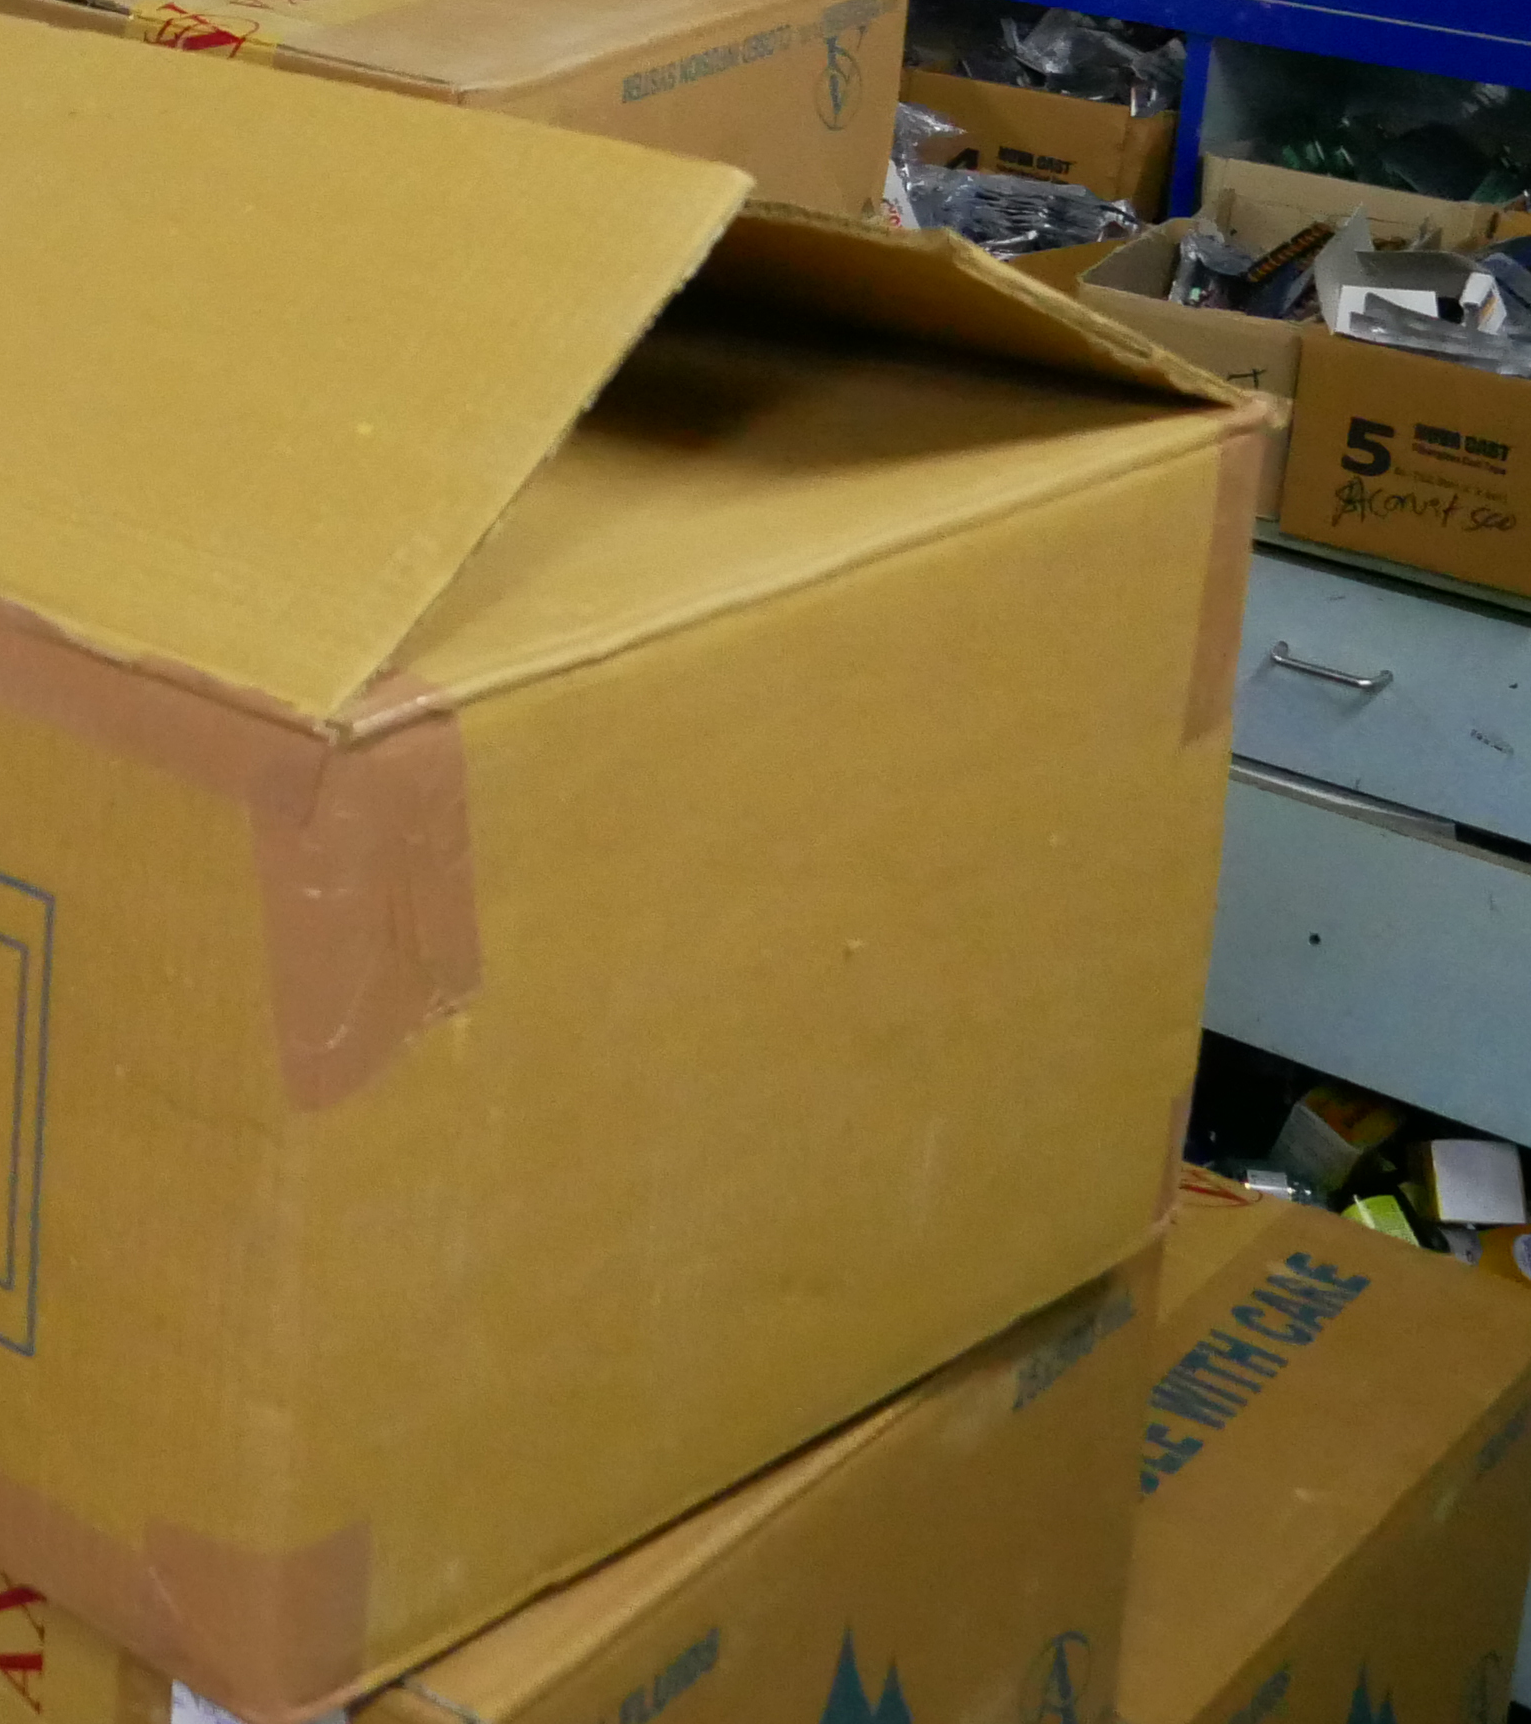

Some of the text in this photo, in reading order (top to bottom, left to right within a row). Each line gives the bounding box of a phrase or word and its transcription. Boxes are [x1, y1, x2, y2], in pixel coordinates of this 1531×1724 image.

[1341, 416, 1395, 477] 5
[1151, 1327, 1289, 1431] WITH
[1231, 1252, 1370, 1346] CARE
